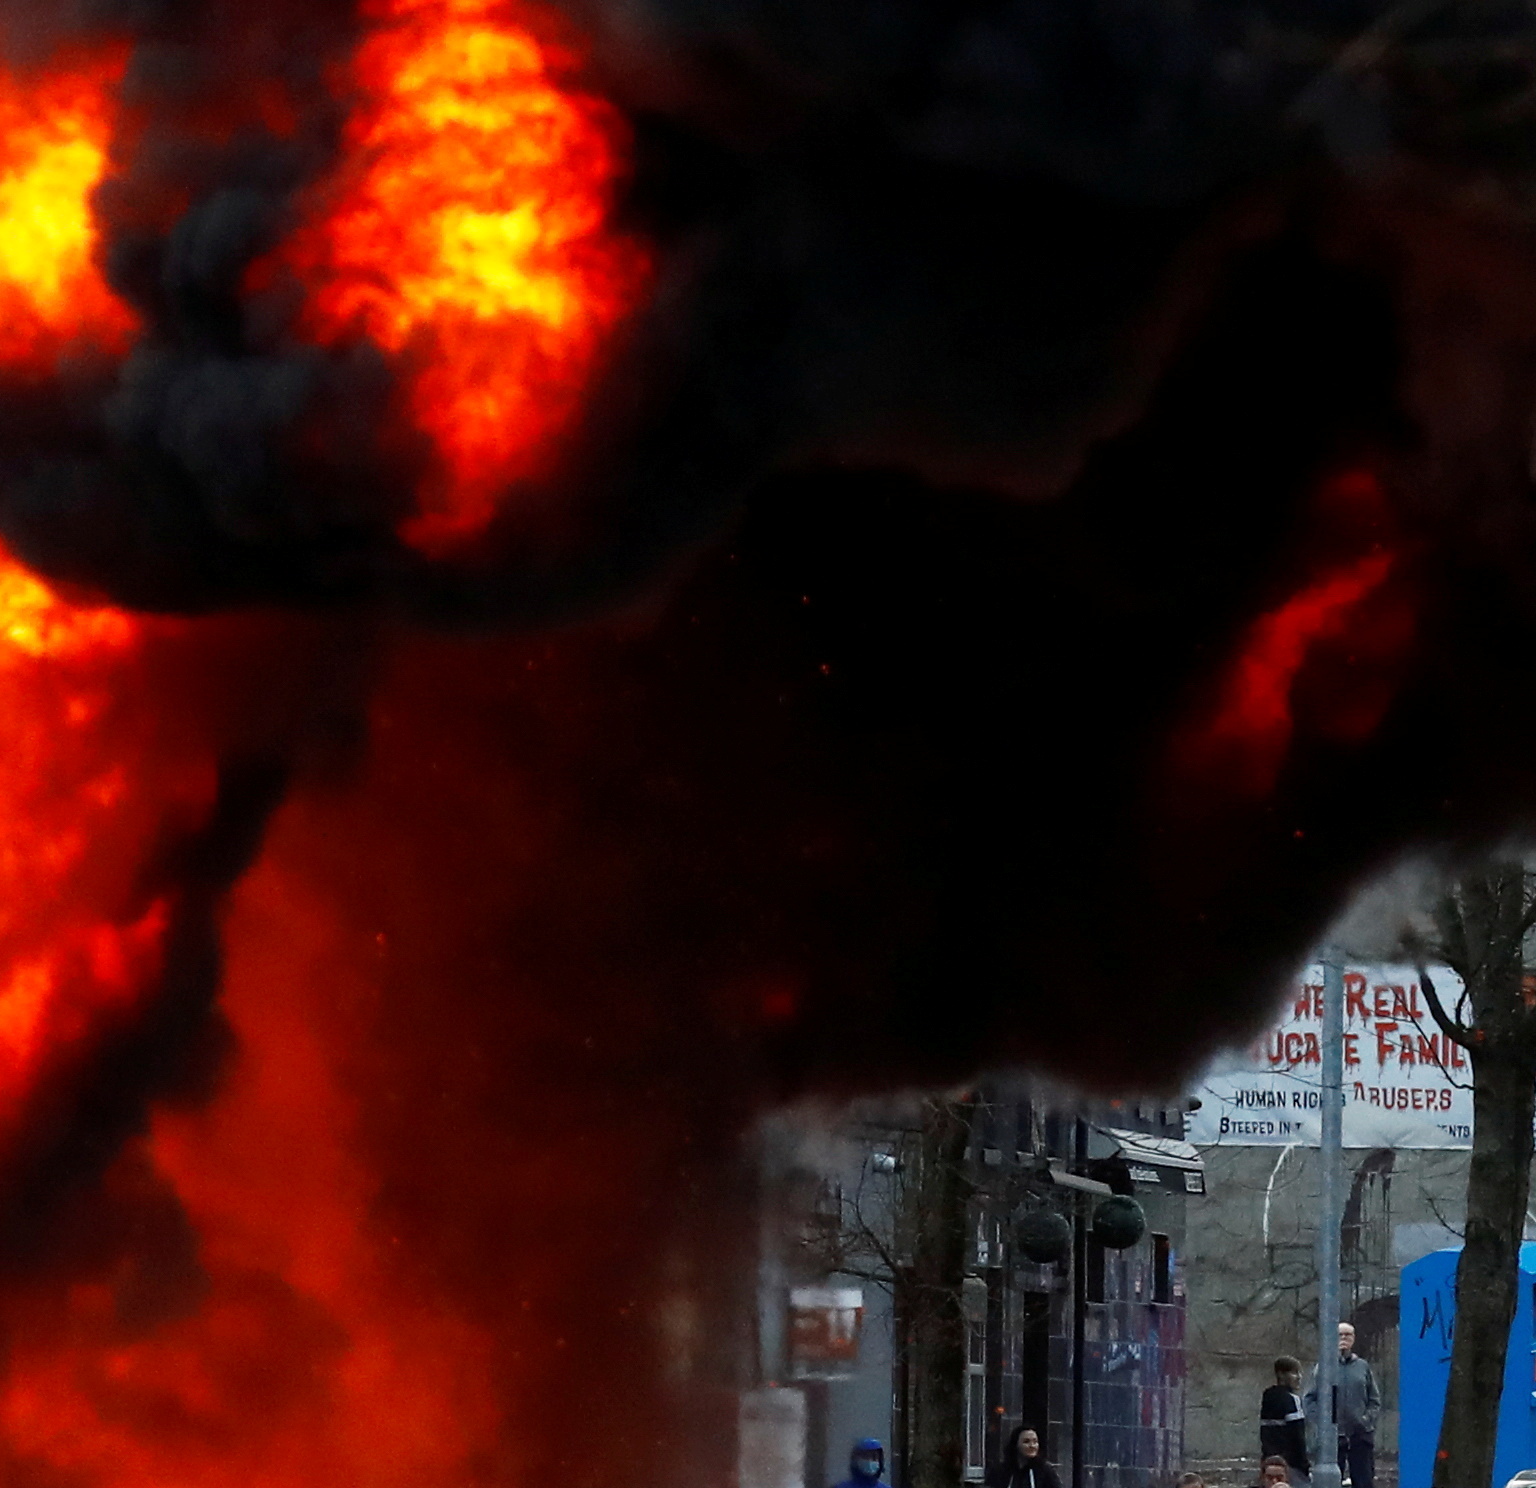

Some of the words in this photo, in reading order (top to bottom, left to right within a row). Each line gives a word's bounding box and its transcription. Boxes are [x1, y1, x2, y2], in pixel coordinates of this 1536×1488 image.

[1342, 971, 1423, 1018] REAL
[1235, 1091, 1287, 1108] HUMAN
[1353, 1081, 1453, 1112] ABUSERS
[1219, 1117, 1274, 1135] STEEPED
[1279, 1121, 1291, 1135] IN
